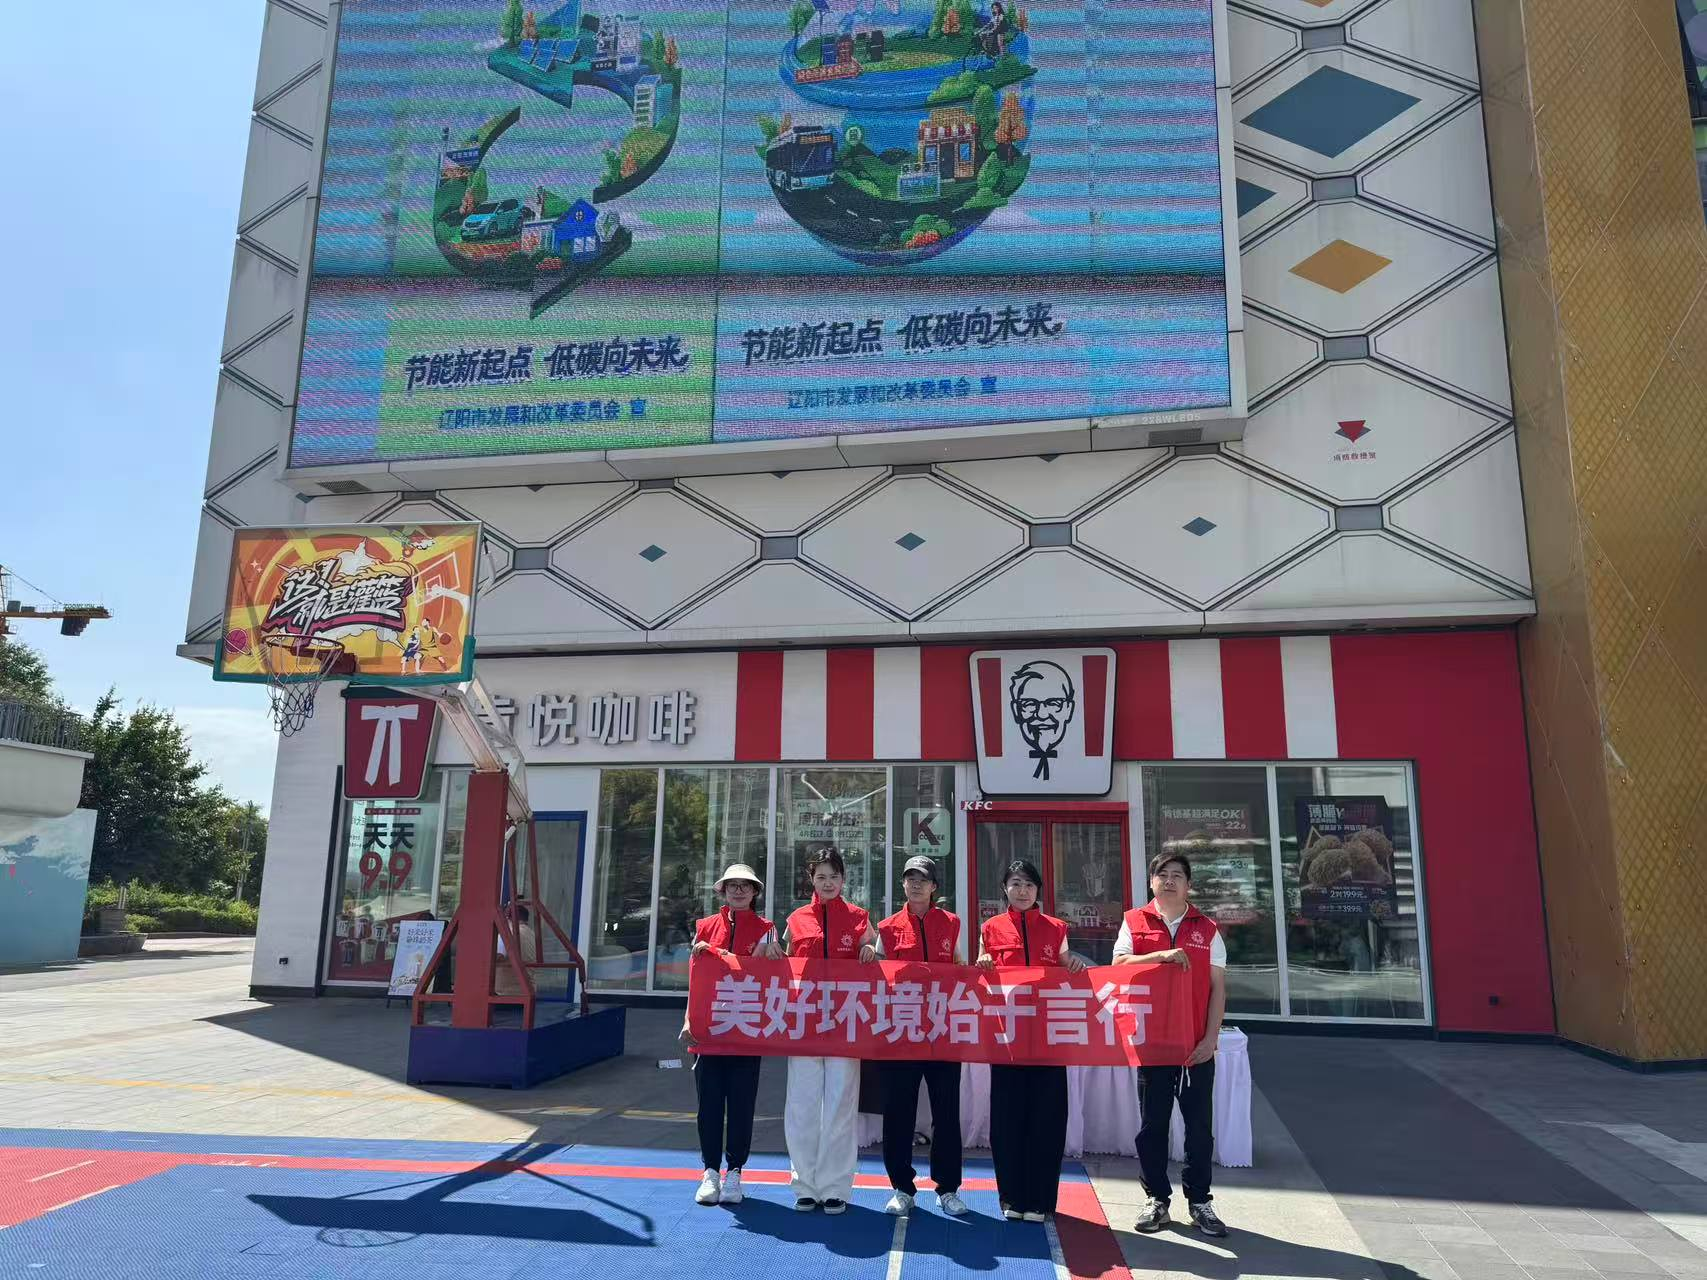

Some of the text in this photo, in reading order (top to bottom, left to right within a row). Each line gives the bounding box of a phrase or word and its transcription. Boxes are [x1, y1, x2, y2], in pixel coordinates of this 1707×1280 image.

[743, 302, 1062, 365] 节能新起点 低碳向未来
[406, 336, 689, 390] 节能新起点 低碳向未来
[788, 377, 971, 409] 辽阳市发展和改革委员会
[439, 400, 620, 430] 辽阳市发展和改革委员会
[963, 801, 993, 811] KFC
[362, 822, 415, 850] 天天
[910, 812, 942, 846] K
[708, 974, 1153, 1047] 美好环境始于言行
